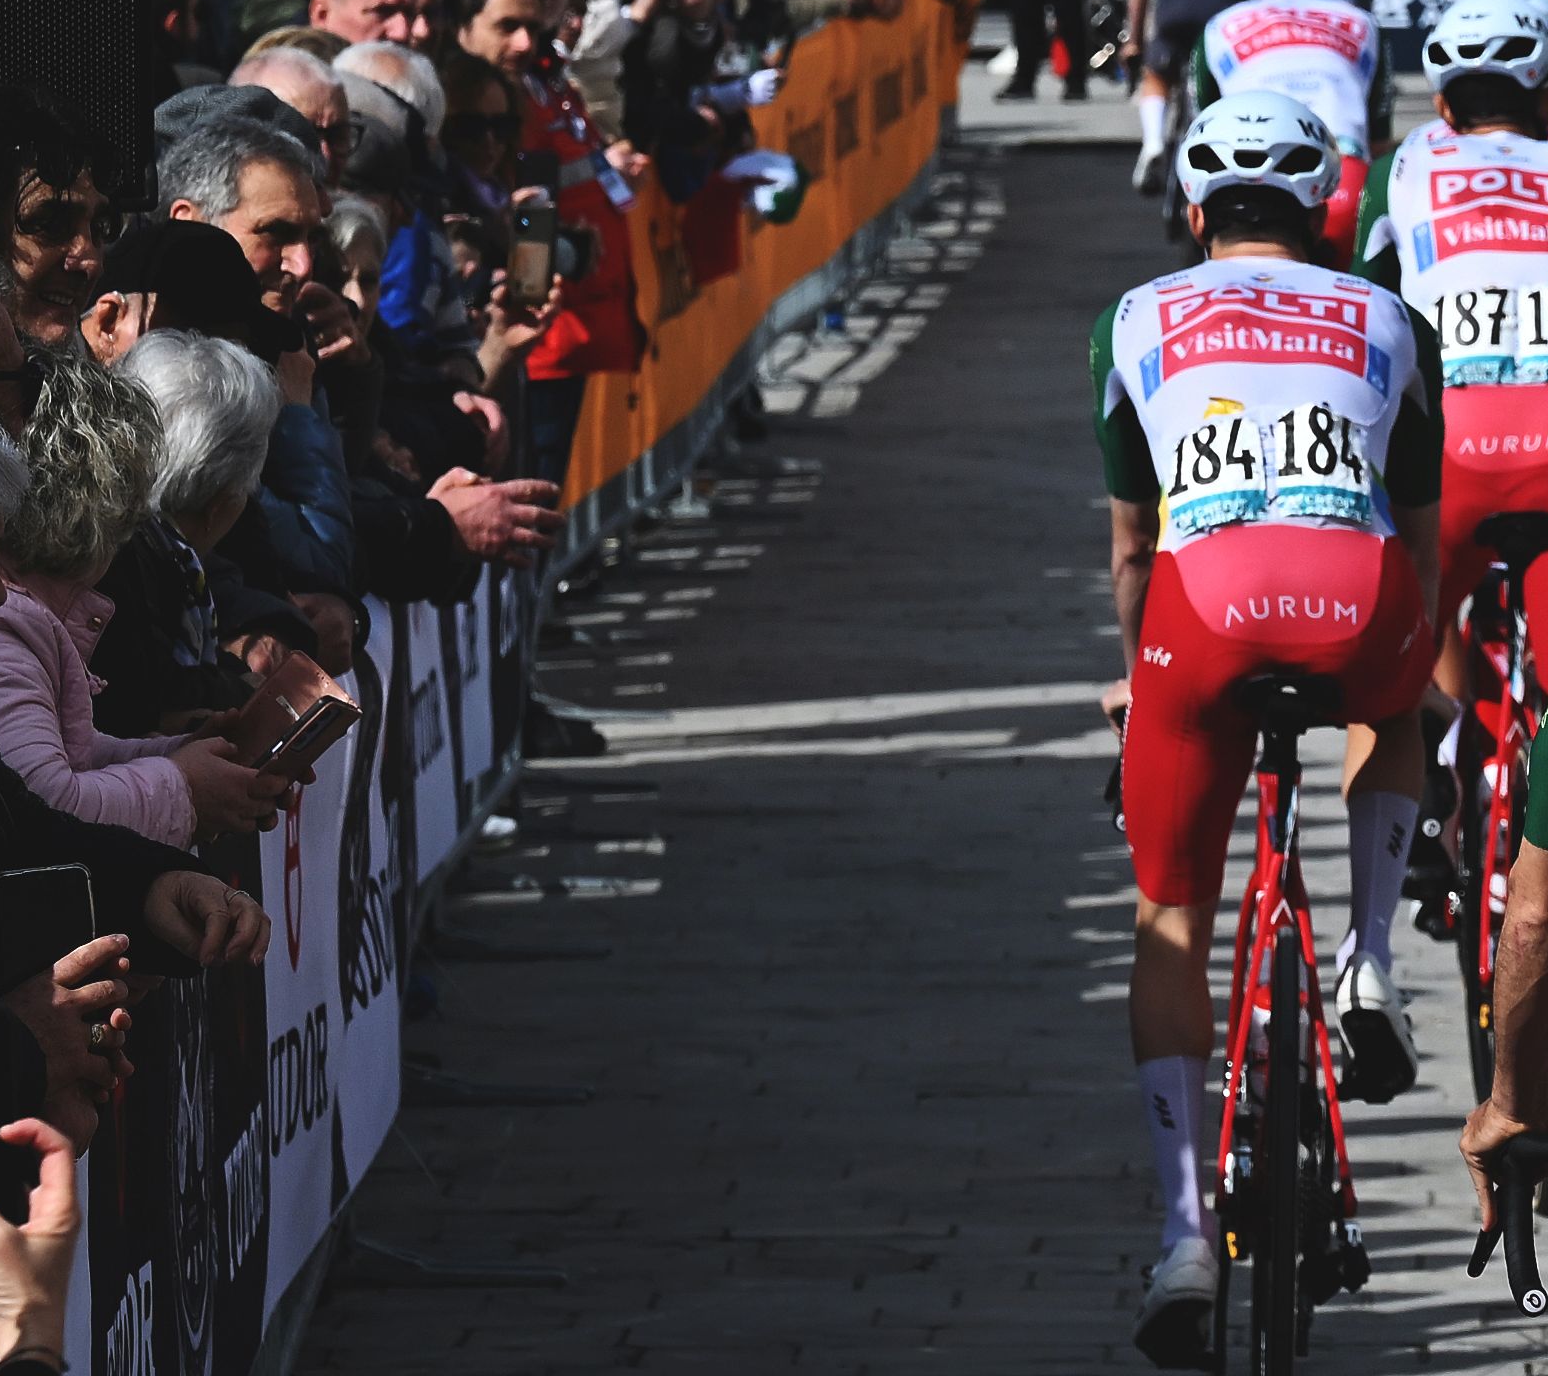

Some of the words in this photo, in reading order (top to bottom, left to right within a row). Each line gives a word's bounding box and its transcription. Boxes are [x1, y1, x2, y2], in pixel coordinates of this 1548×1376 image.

[1168, 284, 1357, 327] POLTI
[1434, 288, 1508, 349] 187
[1170, 322, 1356, 361] VisitMalta
[1168, 418, 1256, 498] 184
[1277, 405, 1364, 484] 184
[1224, 594, 1358, 630] AURUM
